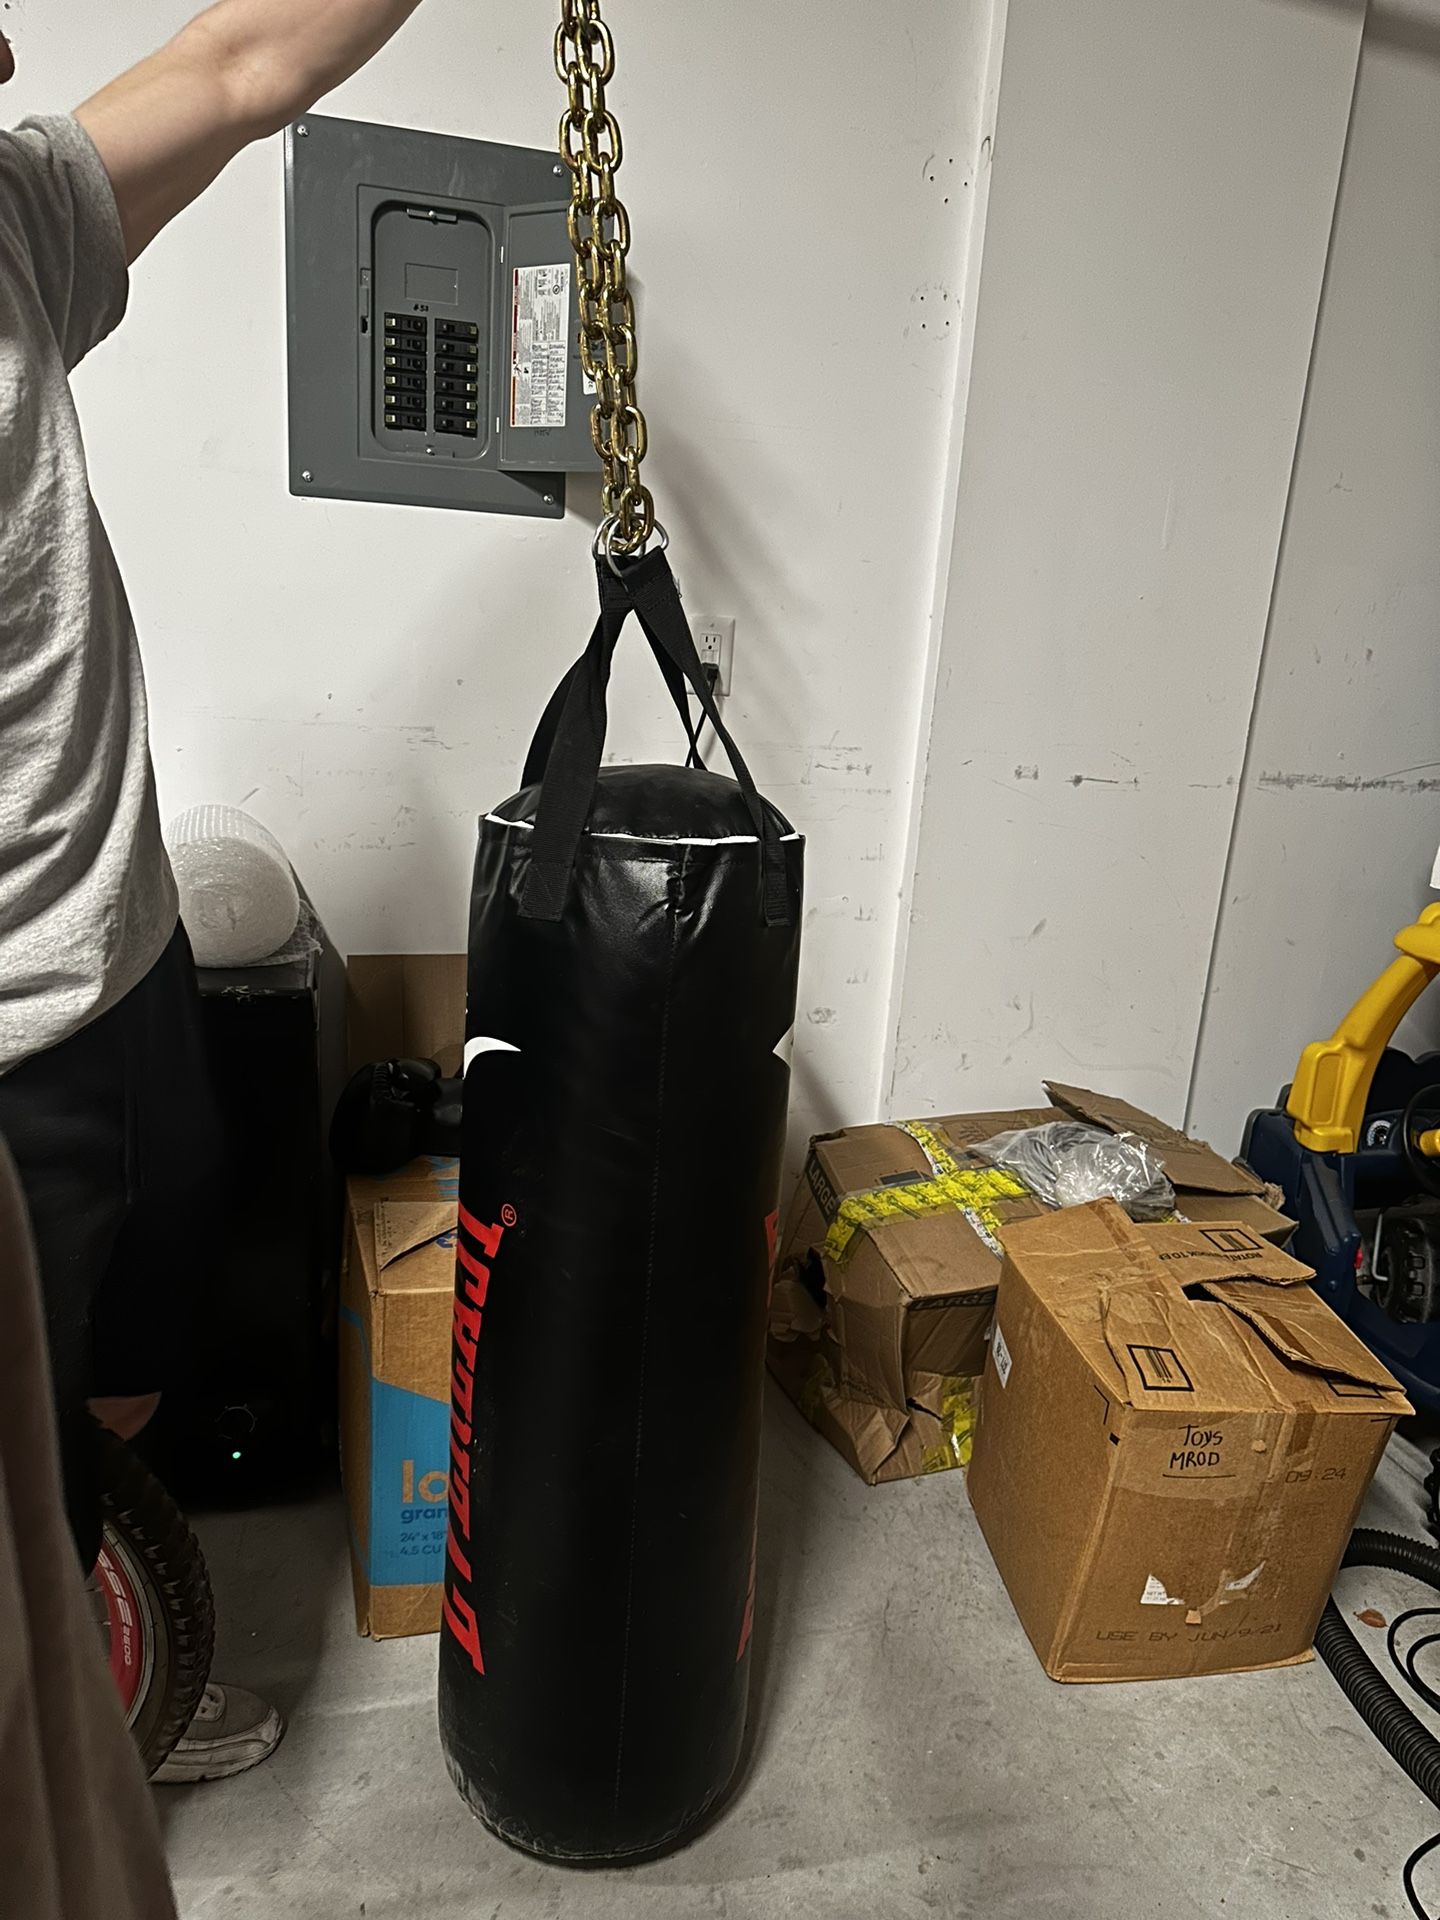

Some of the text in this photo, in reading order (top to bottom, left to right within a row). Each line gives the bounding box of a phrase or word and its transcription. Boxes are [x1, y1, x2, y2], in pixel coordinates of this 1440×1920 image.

[808, 1159, 837, 1216] LARGE
[1170, 1452, 1220, 1470] MROD
[422, 1544, 442, 1554] CU
[1096, 1631, 1139, 1641] USE
[1149, 1632, 1178, 1641] BY
